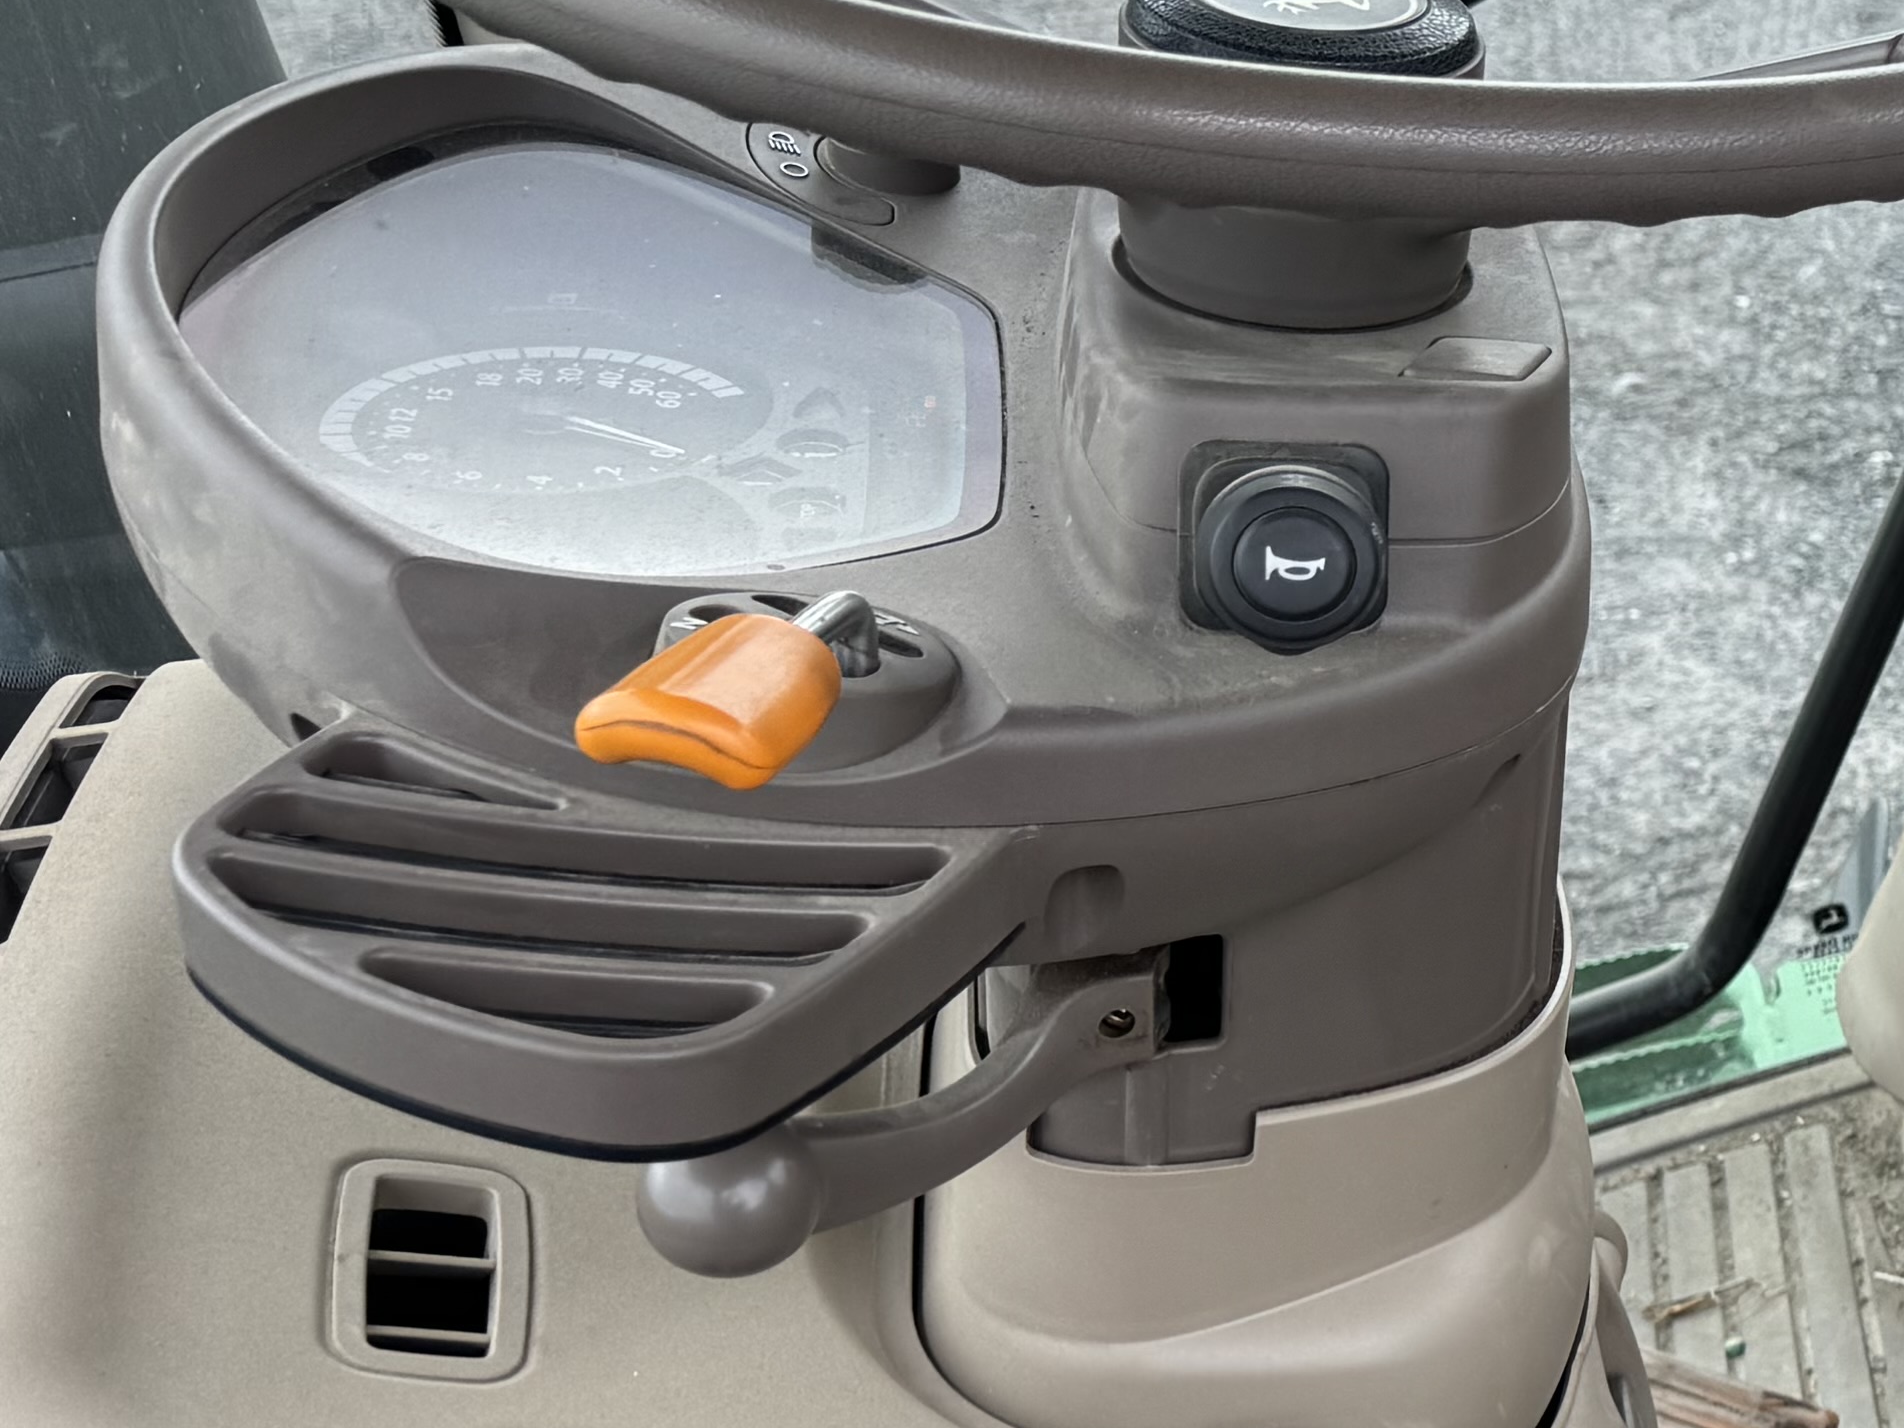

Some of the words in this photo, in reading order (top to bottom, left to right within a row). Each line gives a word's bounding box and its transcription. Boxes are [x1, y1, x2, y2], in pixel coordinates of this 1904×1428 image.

[476, 371, 504, 388] 18
[516, 367, 544, 385] 20
[556, 365, 584, 383] 30
[596, 369, 626, 389] 40
[425, 386, 454, 402] 15
[628, 378, 656, 396] 50
[655, 390, 682, 409] 60
[388, 406, 418, 422] 12
[384, 424, 413, 440] 10
[594, 465, 625, 479] 2
